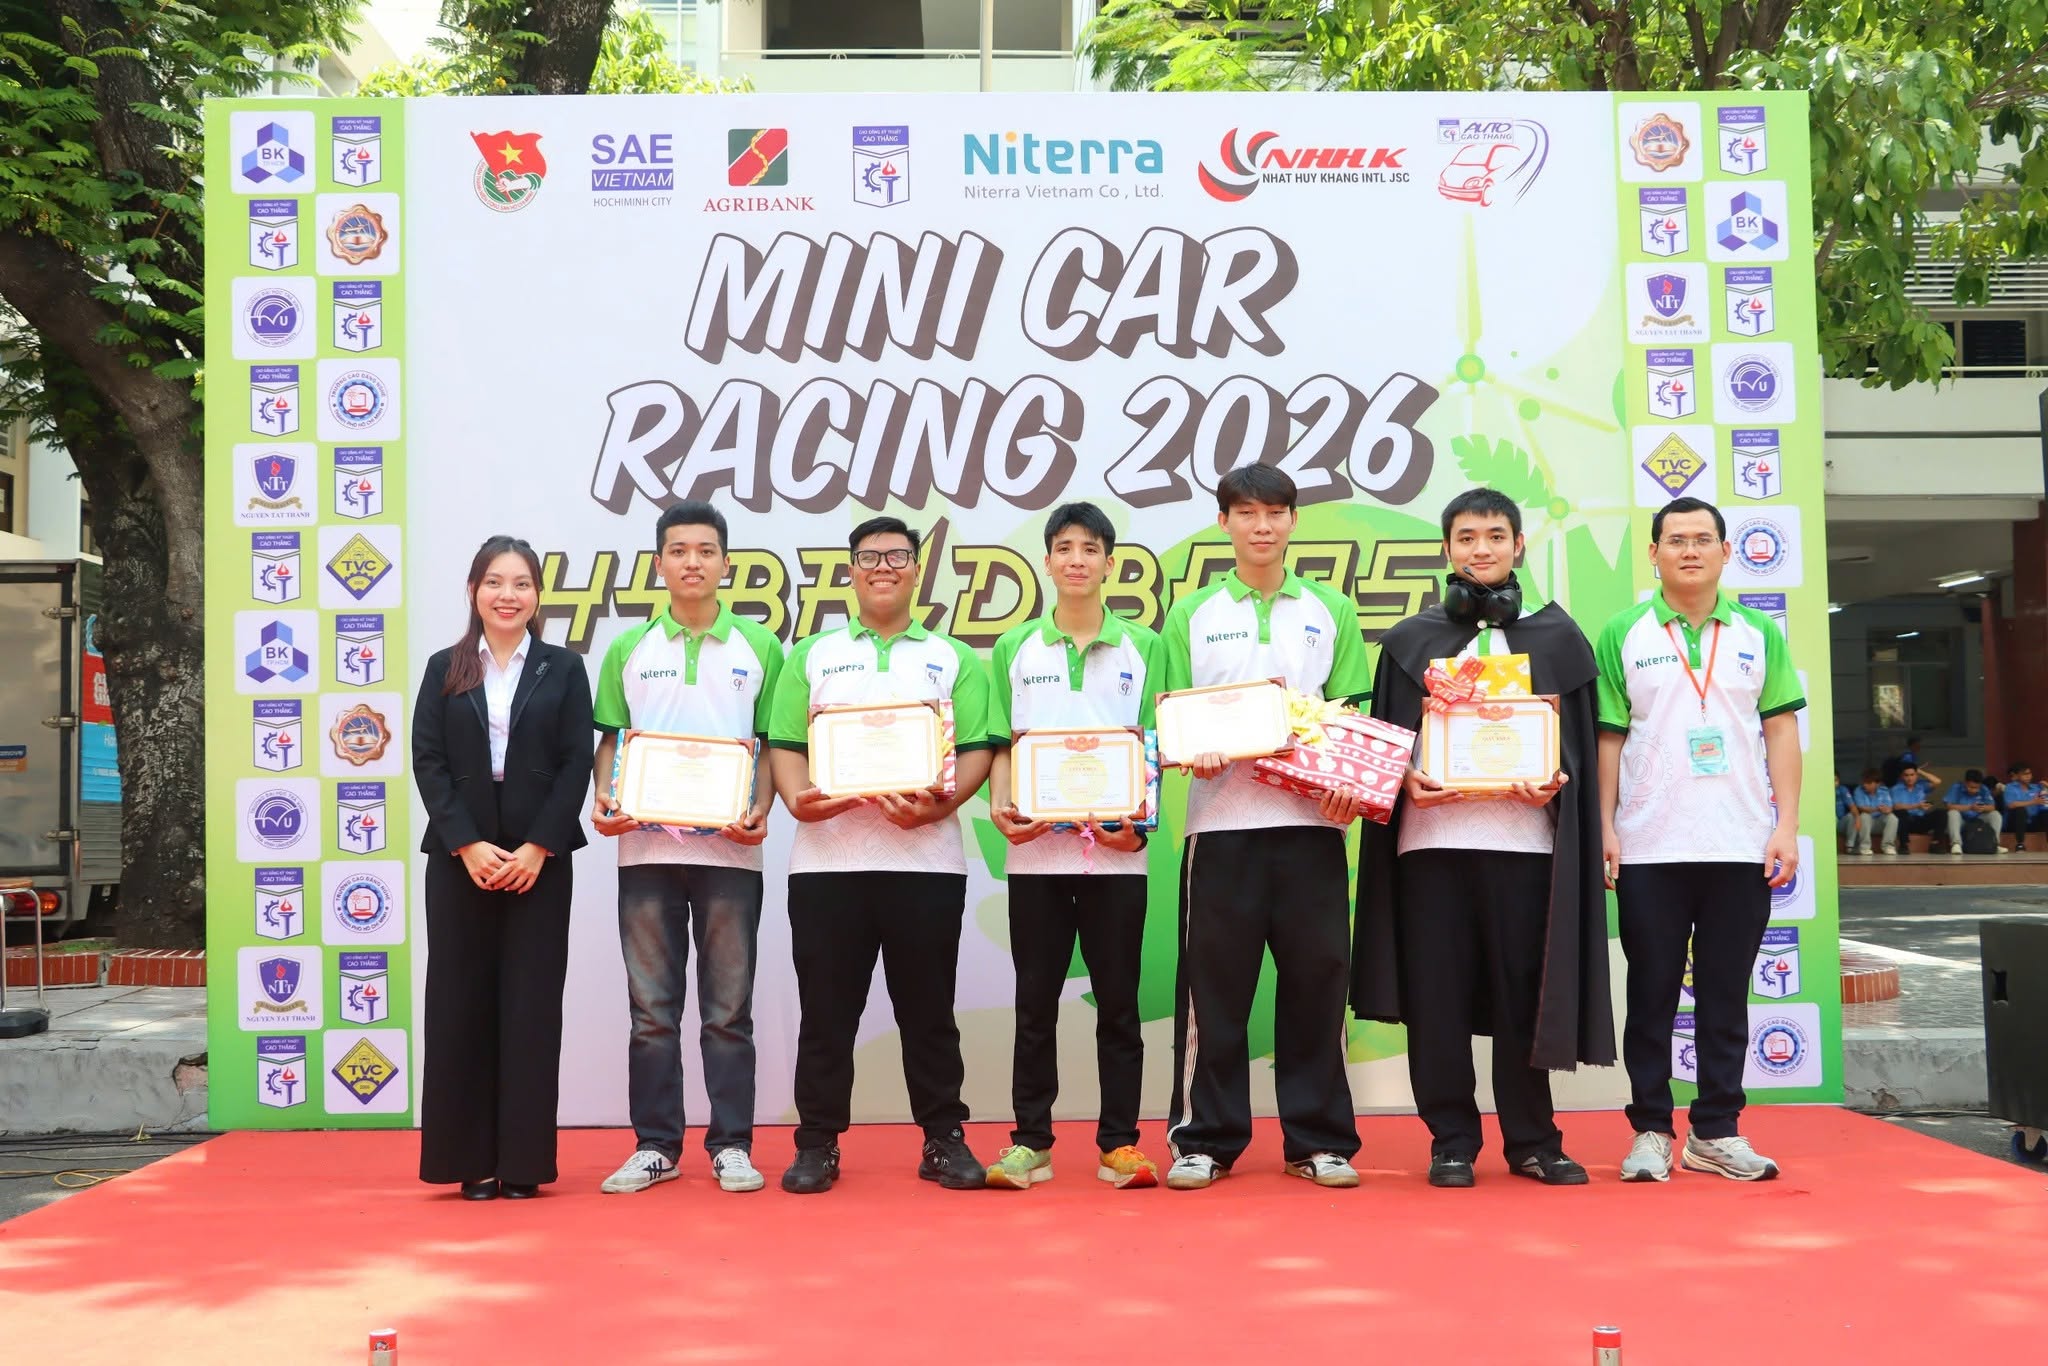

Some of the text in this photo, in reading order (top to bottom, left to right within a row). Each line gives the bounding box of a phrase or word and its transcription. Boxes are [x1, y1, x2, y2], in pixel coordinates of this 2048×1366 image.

[1464, 122, 1512, 133] AUTO
[262, 148, 284, 160] BK
[592, 134, 673, 164] SAE
[964, 132, 1164, 175] Niterra
[593, 172, 673, 188] VIETNAM
[1262, 172, 1410, 183] NHAT HUY KHANG INTL JSC
[965, 185, 1020, 199] Niterra
[1026, 184, 1094, 198] Vietnam
[1136, 184, 1164, 198] Ltd.
[594, 196, 672, 207] HOCHIMINH CITY
[703, 196, 815, 212] AGRIBANK
[1736, 217, 1758, 228] BK
[685, 226, 1299, 365] MINI CAR
[1656, 295, 1680, 309] NTT
[591, 373, 1444, 515] RACING 2026
[1657, 459, 1691, 470] TVC
[263, 476, 288, 491] NTT
[341, 560, 377, 571] TVC
[1206, 630, 1248, 644] Niterra
[266, 647, 288, 658] BK
[1635, 654, 1678, 670] Niterra
[640, 670, 677, 680] Niterra
[822, 664, 864, 677] Niterra
[1023, 674, 1060, 686] Niterra
[268, 980, 293, 994] NTT
[347, 1065, 383, 1075] TVC
